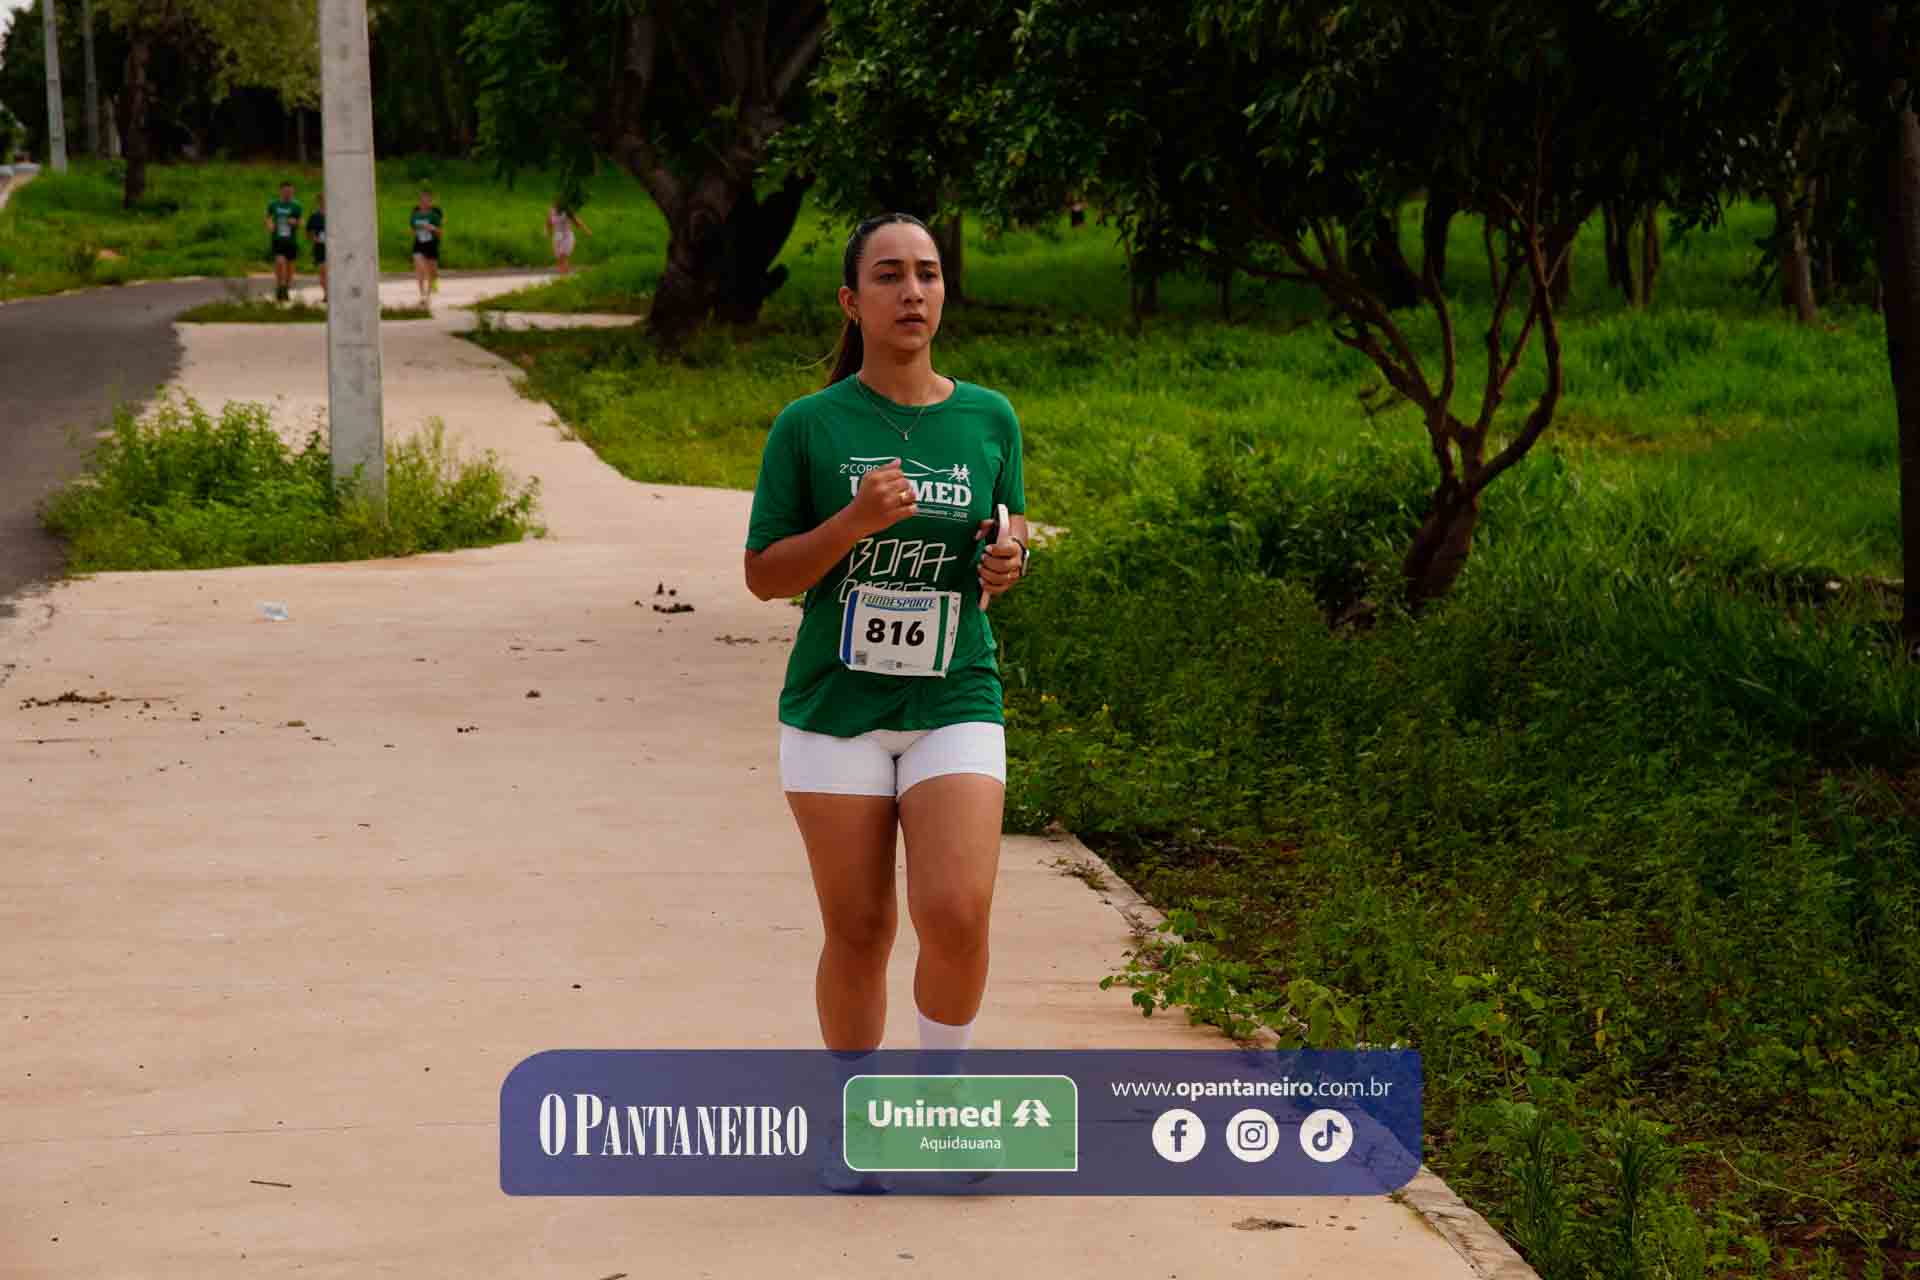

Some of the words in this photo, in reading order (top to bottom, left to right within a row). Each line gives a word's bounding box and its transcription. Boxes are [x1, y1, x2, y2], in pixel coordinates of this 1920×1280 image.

[838, 537, 957, 583] BORA
[862, 593, 934, 609] FUNDESPORTE
[866, 618, 925, 646] 816
